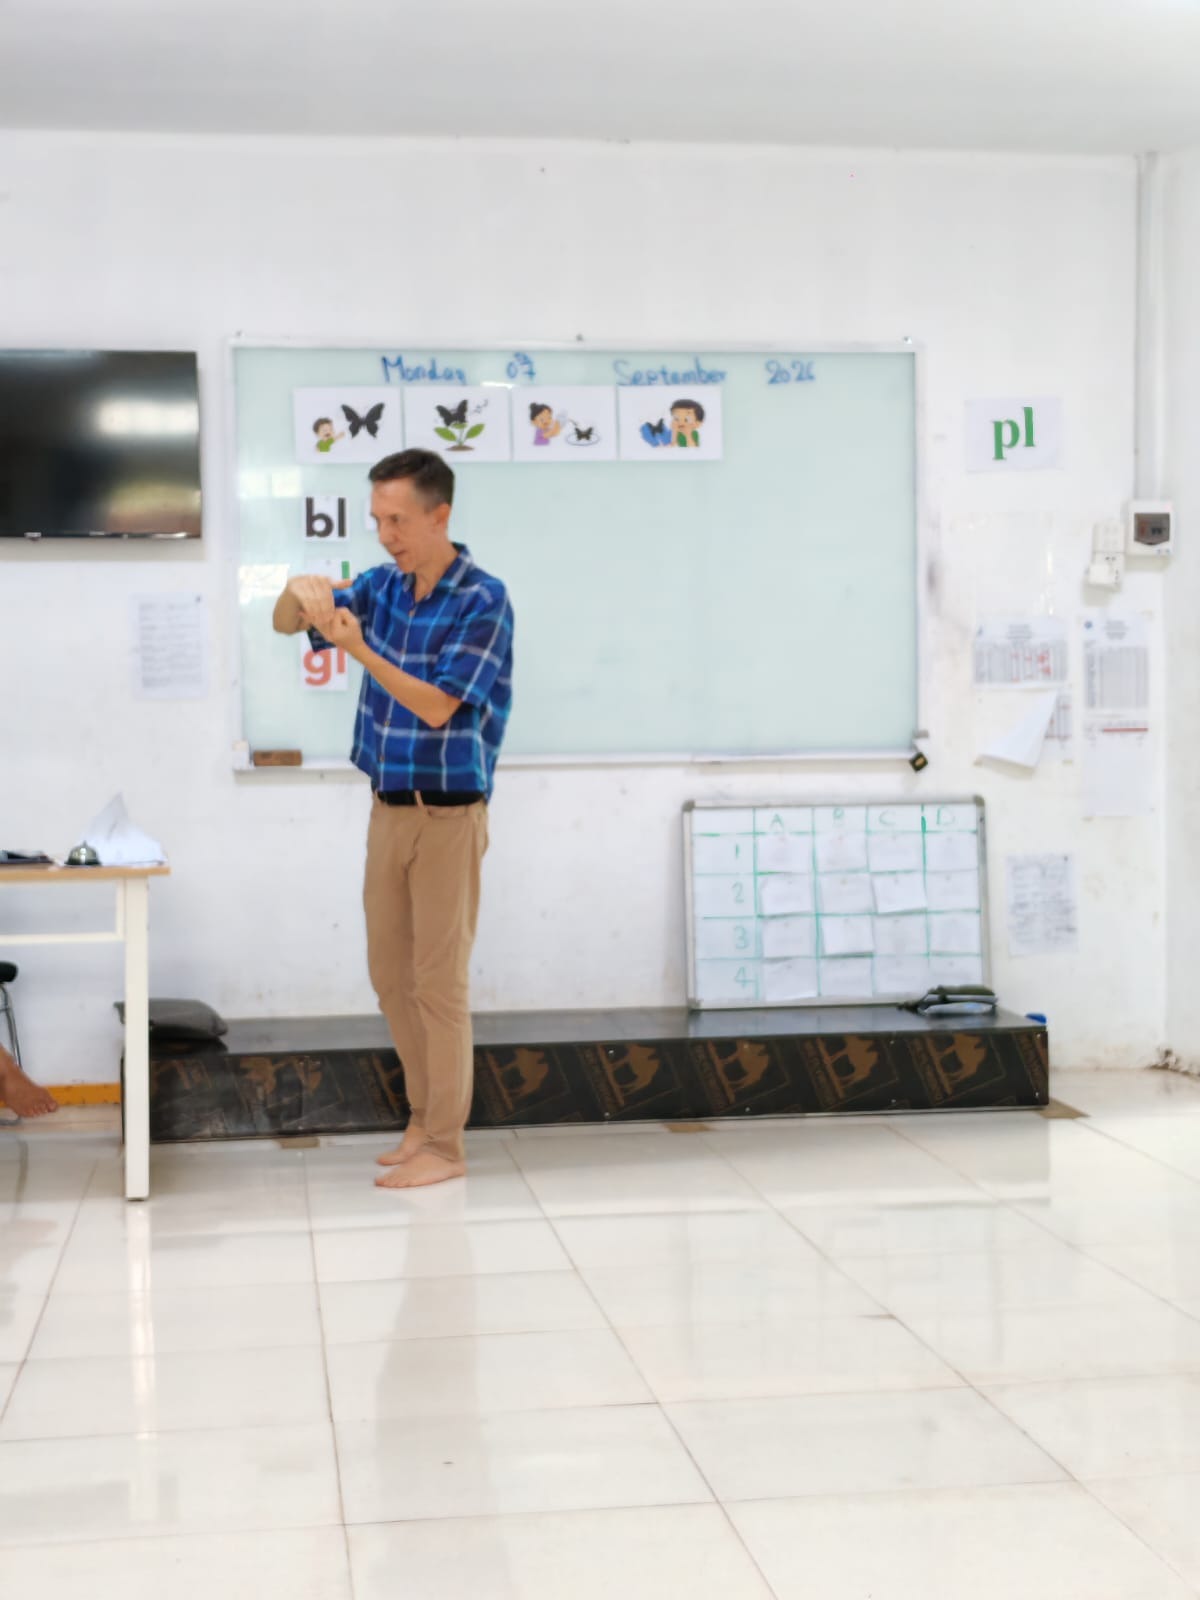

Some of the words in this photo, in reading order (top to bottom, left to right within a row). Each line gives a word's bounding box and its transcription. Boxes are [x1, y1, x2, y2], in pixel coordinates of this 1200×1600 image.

[381, 355, 467, 386] Monday
[612, 354, 728, 385] September
[991, 407, 1036, 460] pl
[306, 497, 346, 537] bl
[770, 813, 785, 828] A
[732, 882, 746, 904] 2
[733, 926, 748, 949] 3
[733, 967, 755, 989] 4
